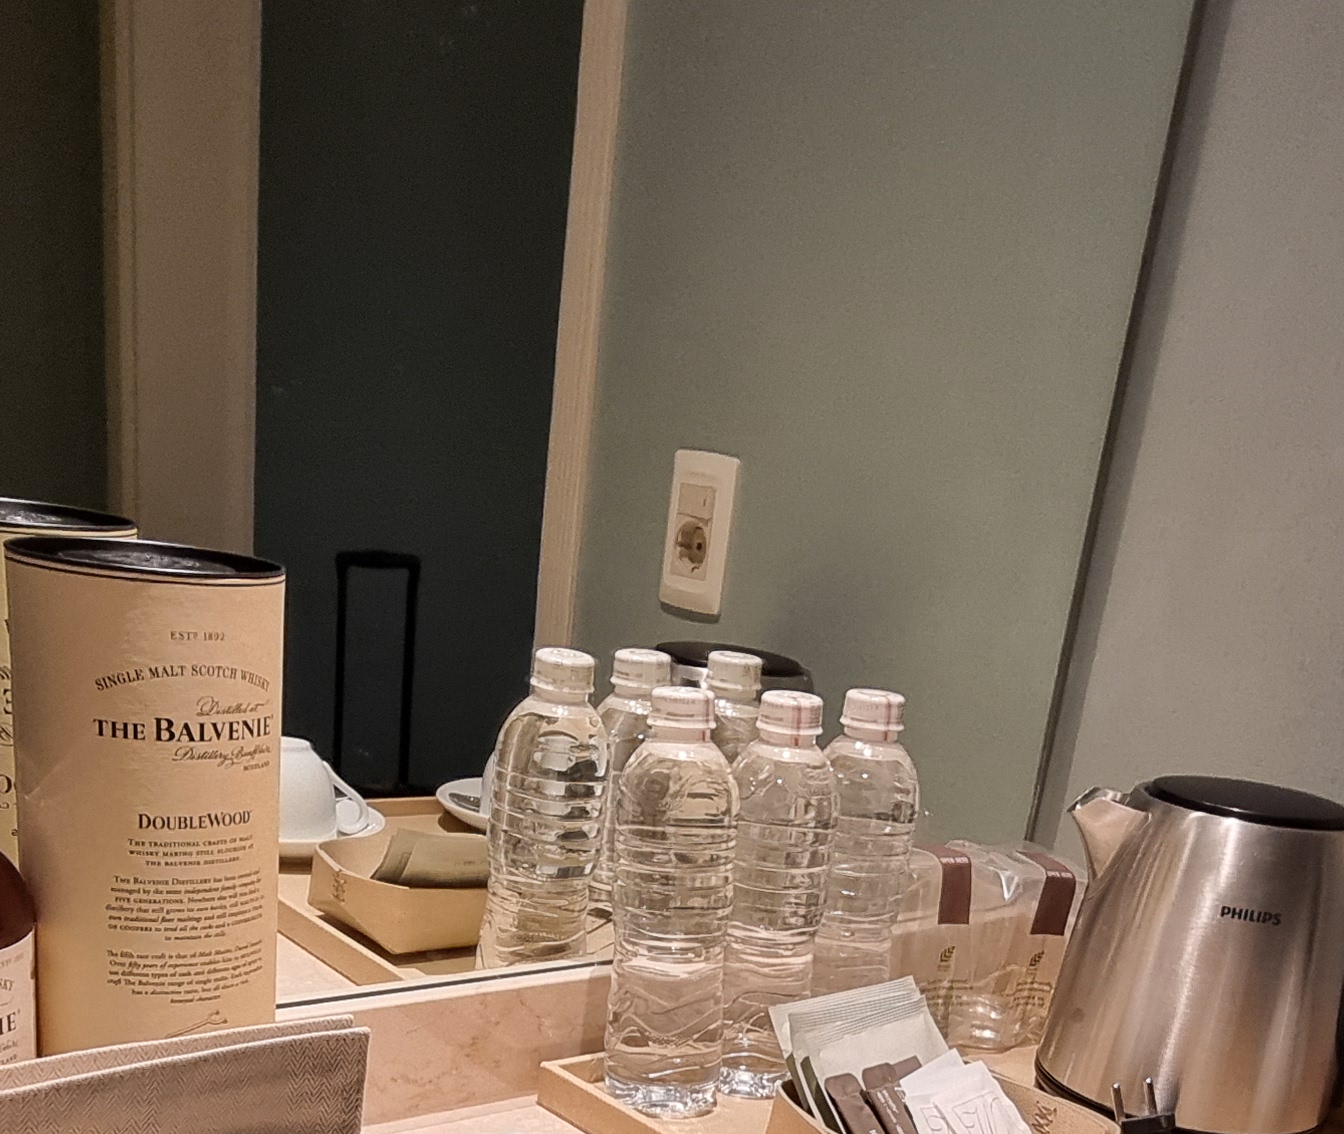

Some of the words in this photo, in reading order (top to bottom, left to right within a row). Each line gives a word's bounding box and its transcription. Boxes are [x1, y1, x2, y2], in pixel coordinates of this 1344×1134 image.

[203, 632, 225, 641] 1892
[94, 668, 145, 691] SINGLE
[148, 665, 187, 679] MALT
[191, 664, 237, 680] SCOTCH
[240, 670, 271, 692] WHISKY
[92, 717, 146, 742] THE
[154, 714, 272, 743] BALVENIE
[1219, 904, 1283, 927] PHILIPS
